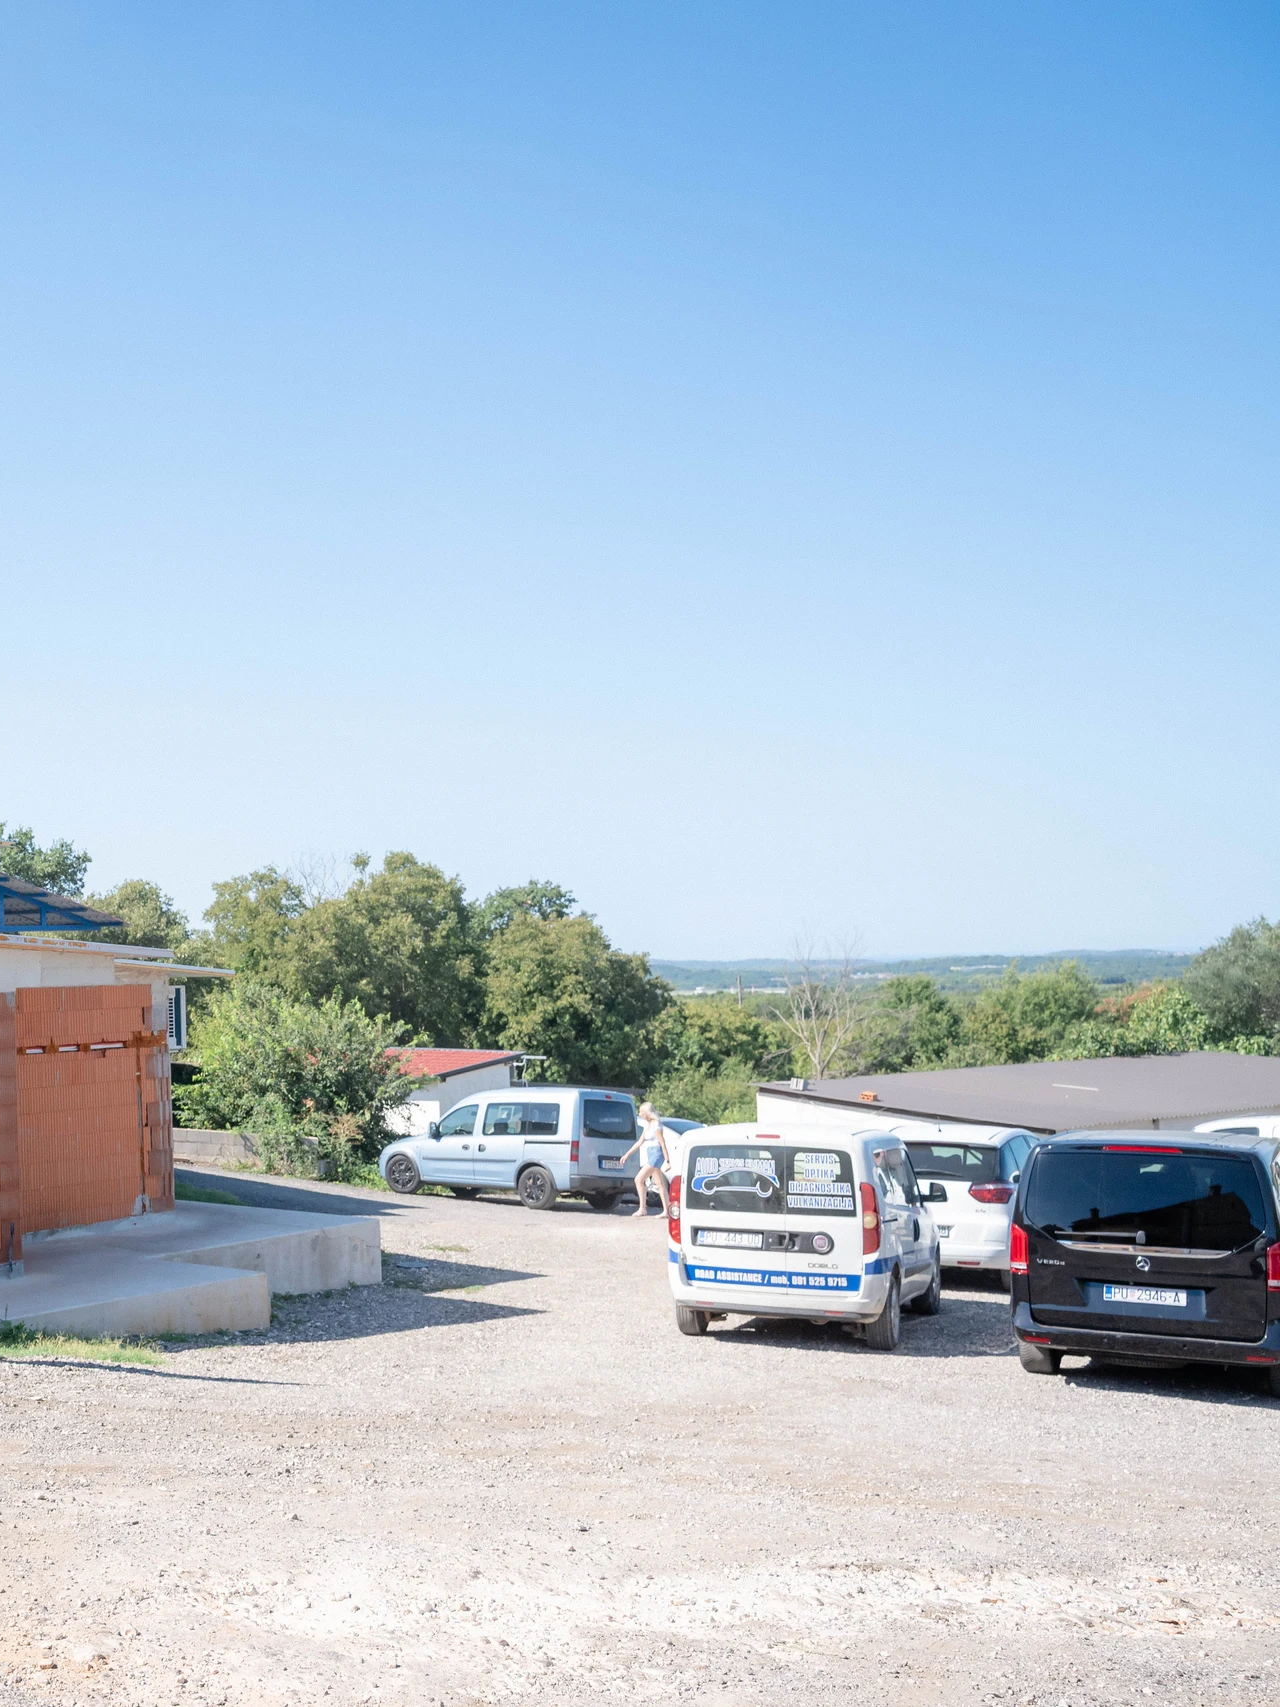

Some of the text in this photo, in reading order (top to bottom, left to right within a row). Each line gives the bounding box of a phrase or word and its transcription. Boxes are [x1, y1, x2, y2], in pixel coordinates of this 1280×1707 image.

[804, 1153, 835, 1165] SERVIS
[695, 1157, 719, 1177] AUTO
[804, 1168, 835, 1179] OPTIKA
[789, 1182, 851, 1194] DIJAGNOSTIKA
[787, 1196, 853, 1209] VULKANIZACIJA
[807, 1262, 839, 1270] DOBLO
[695, 1269, 715, 1279] ROAD
[716, 1270, 763, 1283] ASSISTANCE
[809, 1276, 826, 1287] 525
[827, 1276, 848, 1287] 9715
[1113, 1286, 1129, 1300] PU
